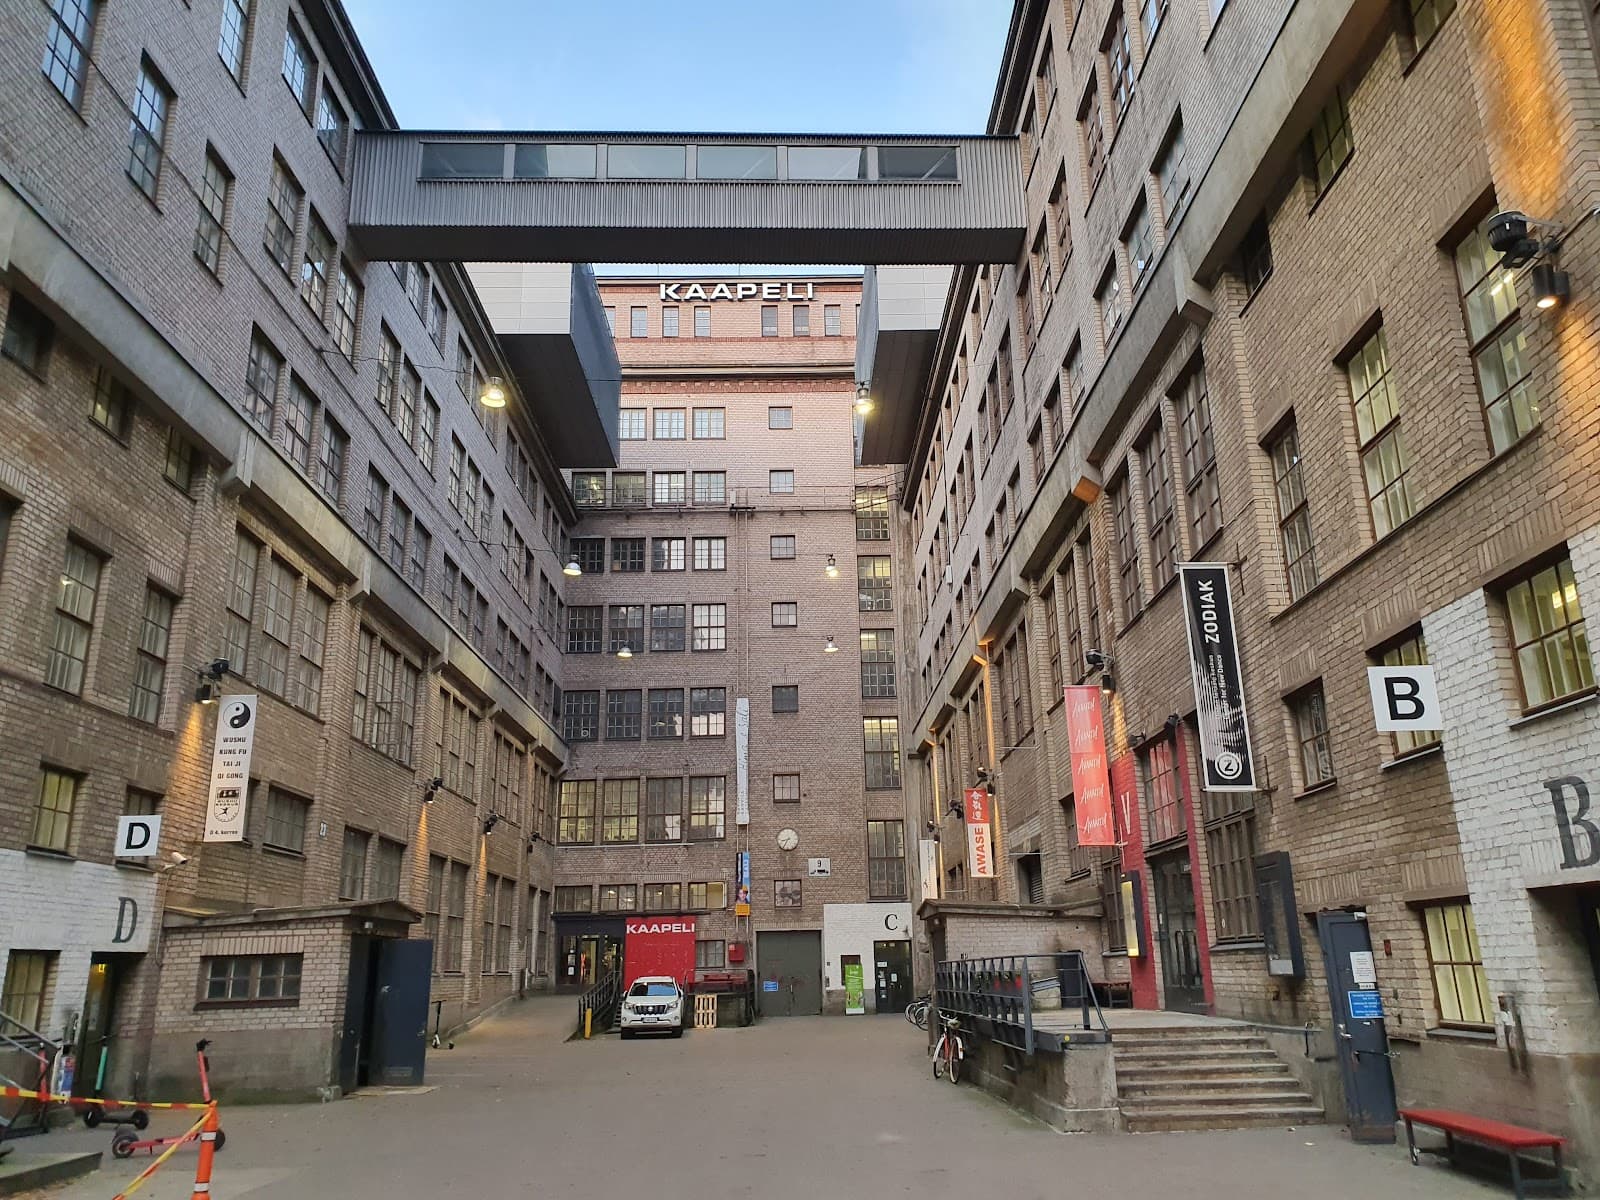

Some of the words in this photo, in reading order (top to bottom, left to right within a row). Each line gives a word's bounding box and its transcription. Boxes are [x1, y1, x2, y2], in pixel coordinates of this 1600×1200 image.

[660, 283, 814, 300] KAAPELI
[1198, 580, 1220, 644] ZODIAK
[1216, 655, 1225, 673] Dance
[1218, 674, 1226, 688] New
[1384, 676, 1425, 720] B
[1543, 776, 1600, 869] B
[125, 823, 150, 849] D
[975, 827, 987, 874] AWASE
[112, 897, 138, 943] D
[626, 923, 695, 934] KAAPELI
[884, 914, 898, 932] C
